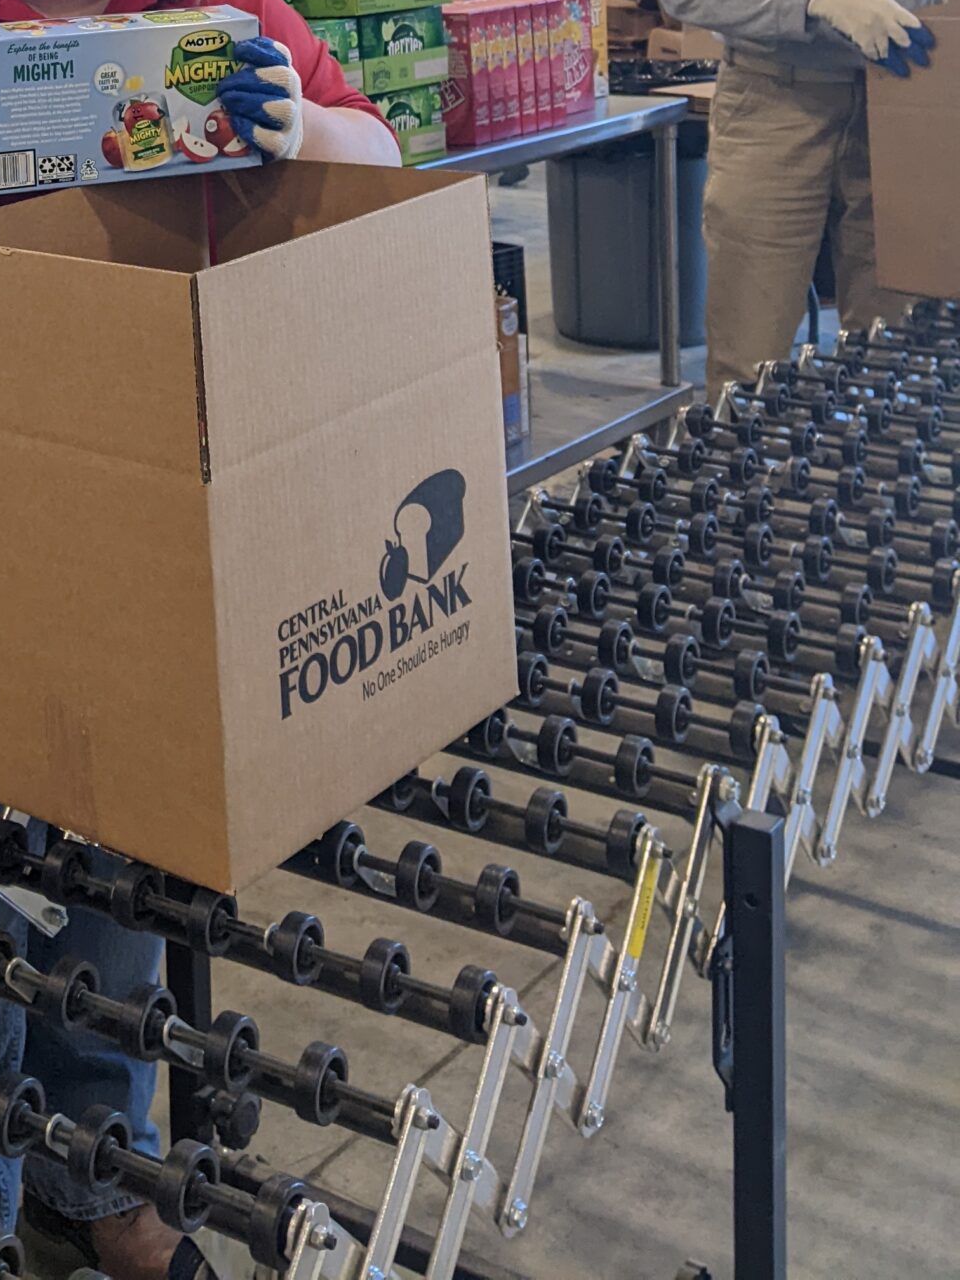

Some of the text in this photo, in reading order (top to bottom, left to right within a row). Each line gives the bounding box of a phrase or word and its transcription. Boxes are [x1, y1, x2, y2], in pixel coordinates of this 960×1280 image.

[7, 39, 80, 55] Explore the benefits
[184, 35, 224, 48] MOTT'S
[28, 52, 58, 62] OF BEING
[13, 59, 74, 84] MIGHTY!
[100, 71, 117, 79] GREAT
[165, 60, 245, 90] MIGHTY
[130, 127, 162, 145] MIGHTY
[278, 589, 348, 642] CENTRAL
[279, 594, 383, 669] PENNSYLVANIA
[279, 562, 472, 720] FOOD BANK
[362, 620, 470, 701] No One Should Be Hungry
